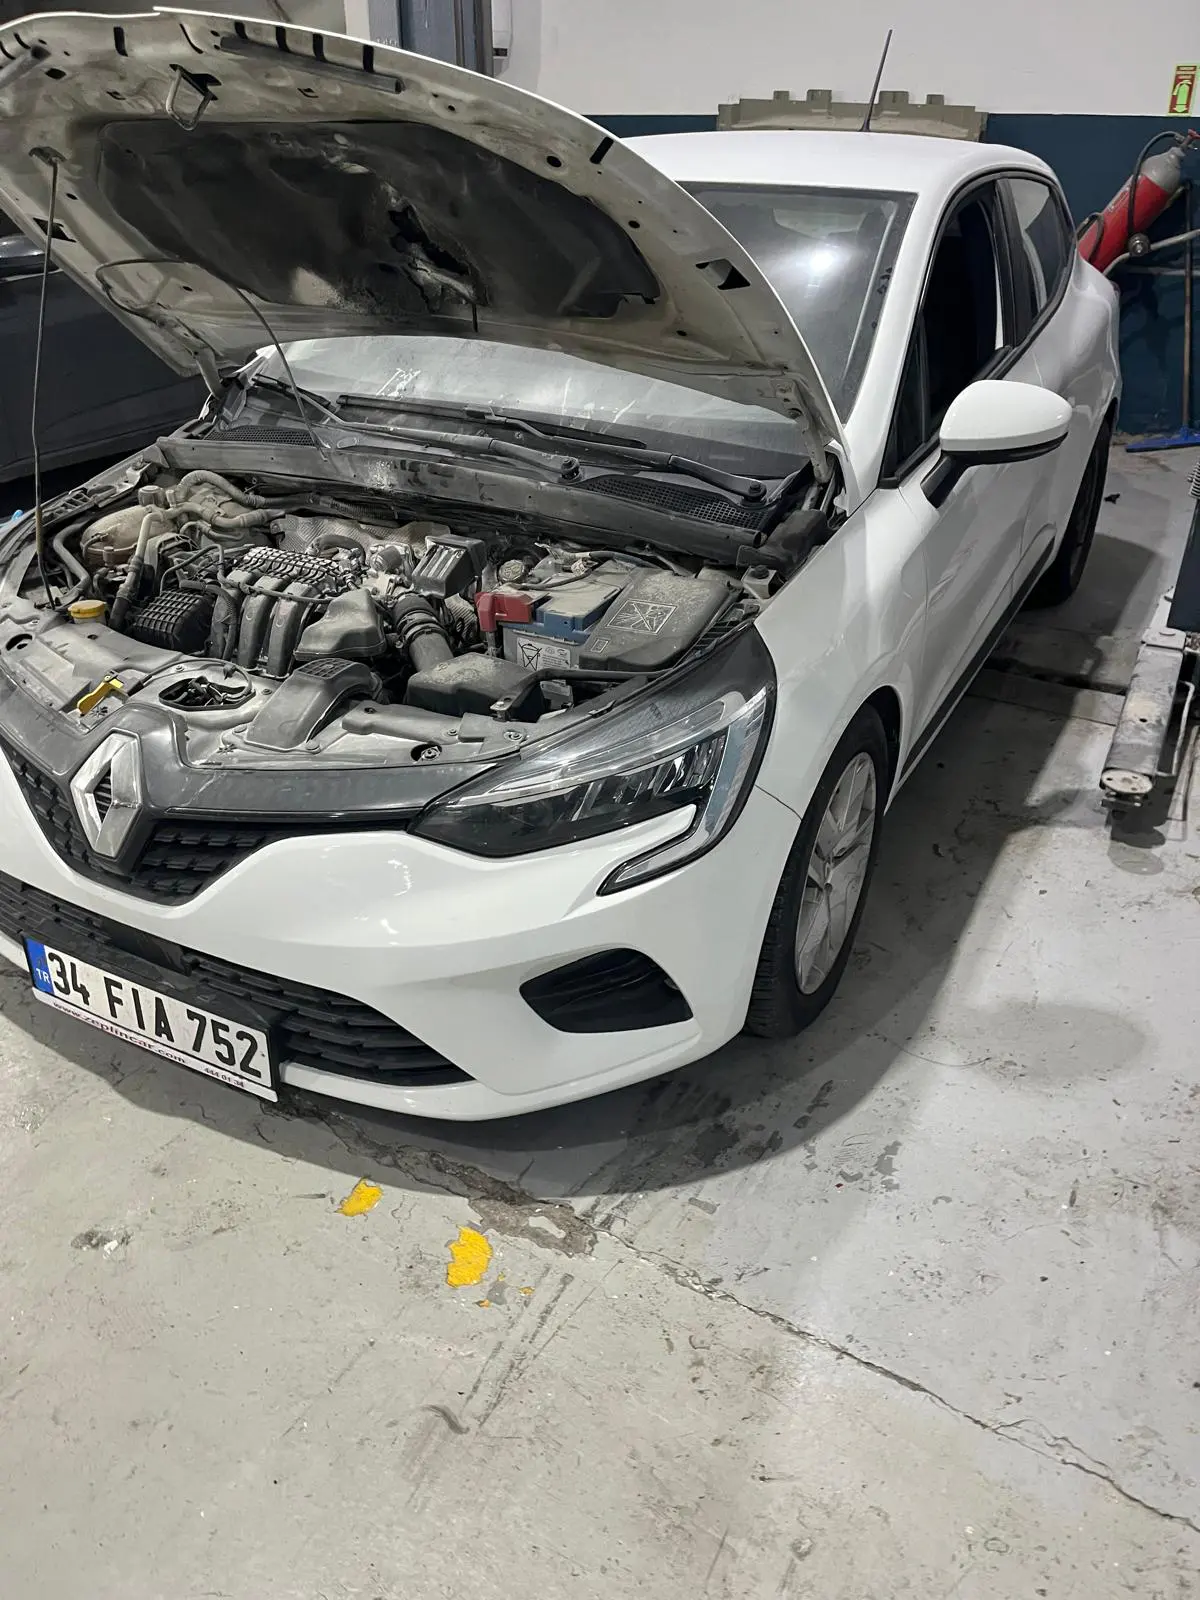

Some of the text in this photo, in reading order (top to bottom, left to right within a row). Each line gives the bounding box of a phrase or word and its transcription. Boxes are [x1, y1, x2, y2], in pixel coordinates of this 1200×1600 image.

[35, 967, 52, 984] TR
[48, 952, 262, 1078] 34 FIA 752
[53, 1001, 187, 1064] www.zeplincar.com
